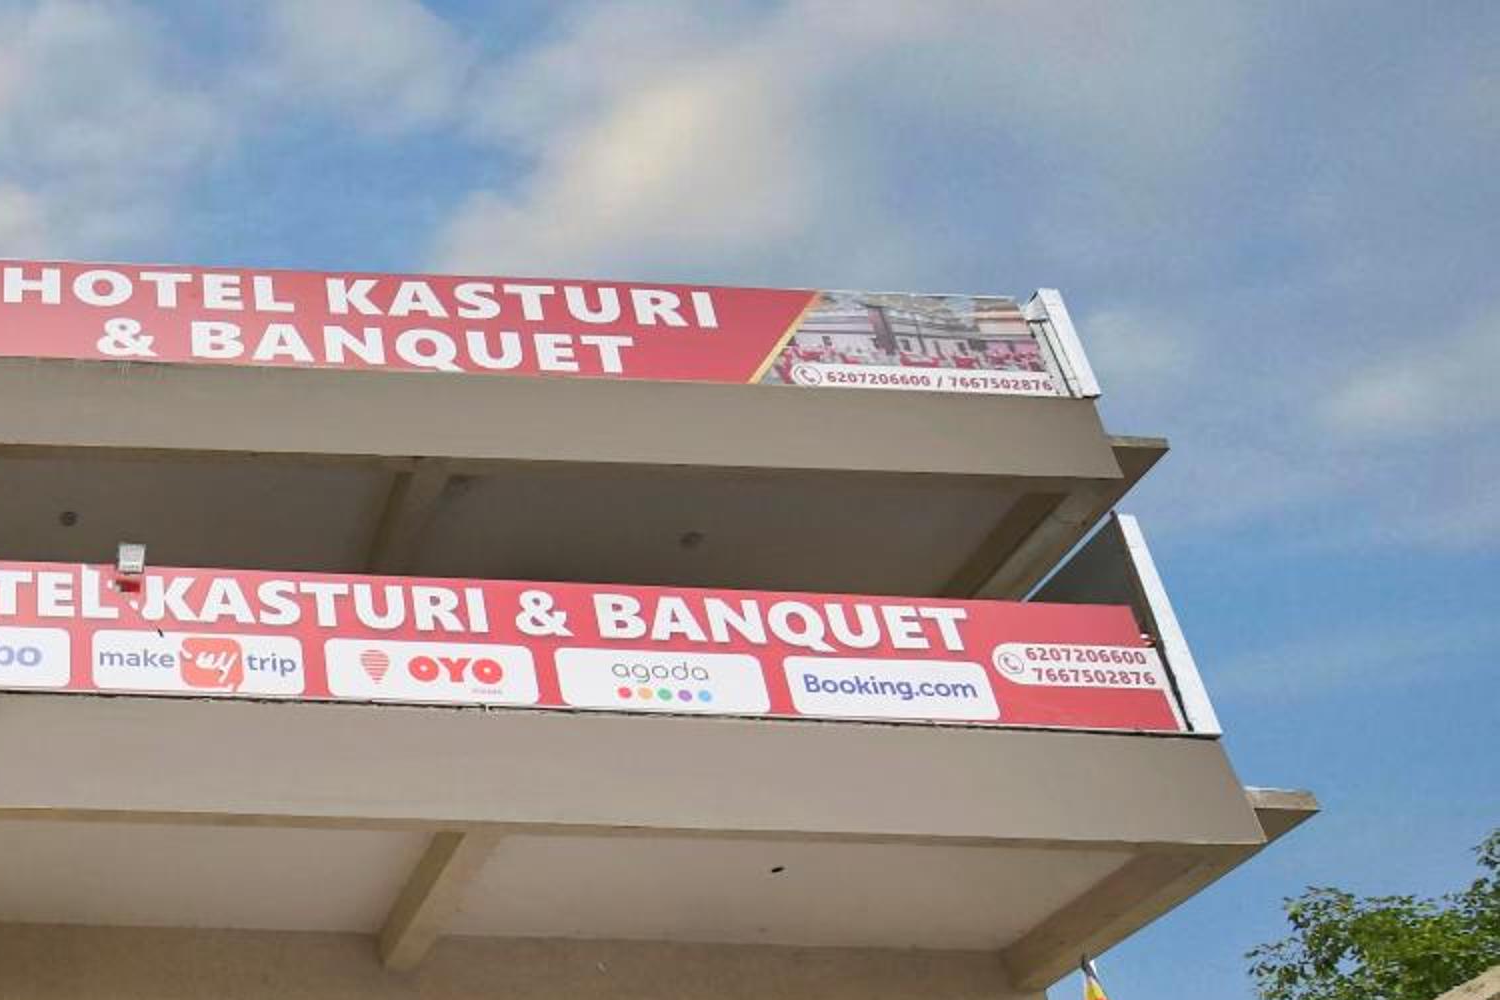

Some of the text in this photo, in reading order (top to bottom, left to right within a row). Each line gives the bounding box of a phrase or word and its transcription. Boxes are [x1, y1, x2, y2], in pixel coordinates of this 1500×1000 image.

[3, 267, 719, 329] HOTEL KASTURI
[97, 317, 635, 375] & BANQUET
[827, 371, 931, 387] 6207206600
[952, 377, 1054, 391] 7667502876
[141, 575, 490, 633] KASTURI
[515, 589, 574, 637] &
[593, 593, 968, 653] BANQUET
[100, 648, 175, 668] make
[247, 652, 297, 678] trip
[408, 655, 503, 685] OYO
[1025, 647, 1147, 665] 6207206600
[611, 660, 710, 683] agoda
[1032, 668, 1157, 685] 7667502876
[803, 673, 979, 701] Booking.com
